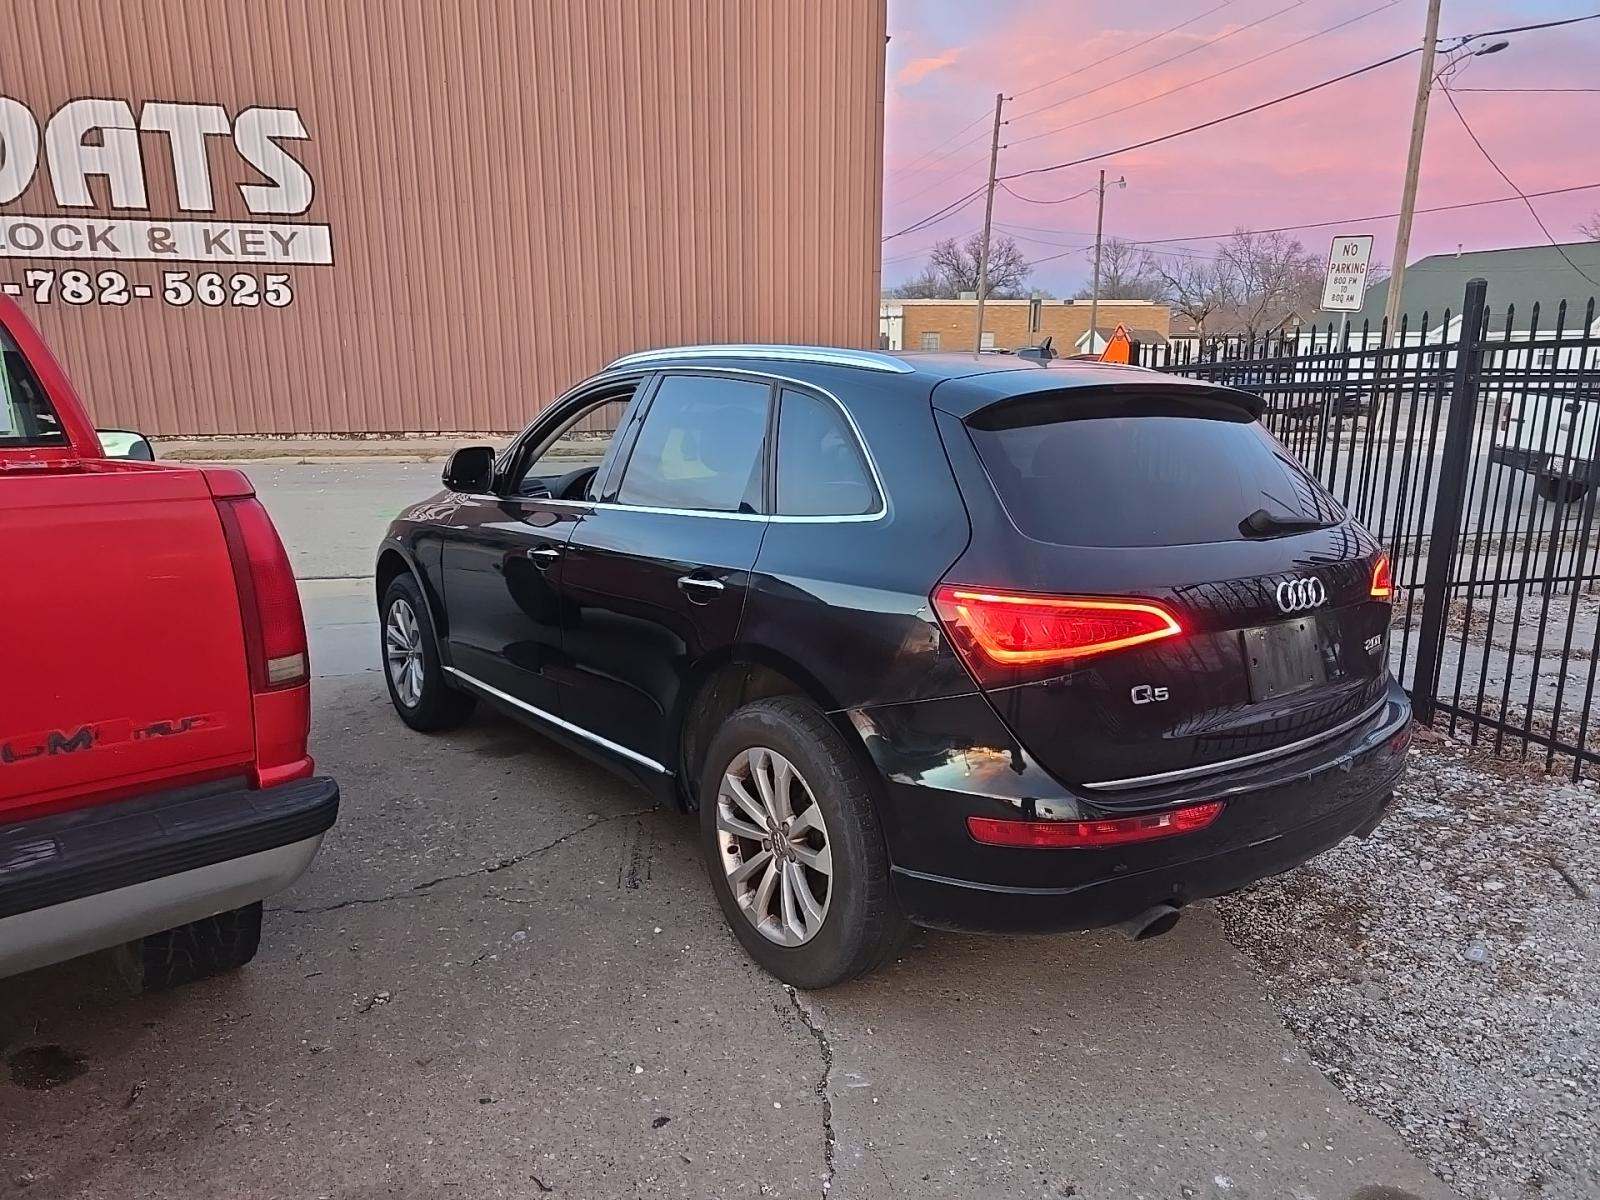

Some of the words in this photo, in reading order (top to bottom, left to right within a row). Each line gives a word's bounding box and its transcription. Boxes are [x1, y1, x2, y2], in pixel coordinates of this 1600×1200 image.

[0, 222, 120, 253] OCK
[147, 227, 179, 253] &
[202, 228, 298, 256] KEY
[1342, 244, 1358, 256] NO
[1330, 263, 1365, 274] PARKING
[1348, 277, 1357, 285] PM
[1346, 294, 1355, 302] AM
[1131, 685, 1169, 704] Q5
